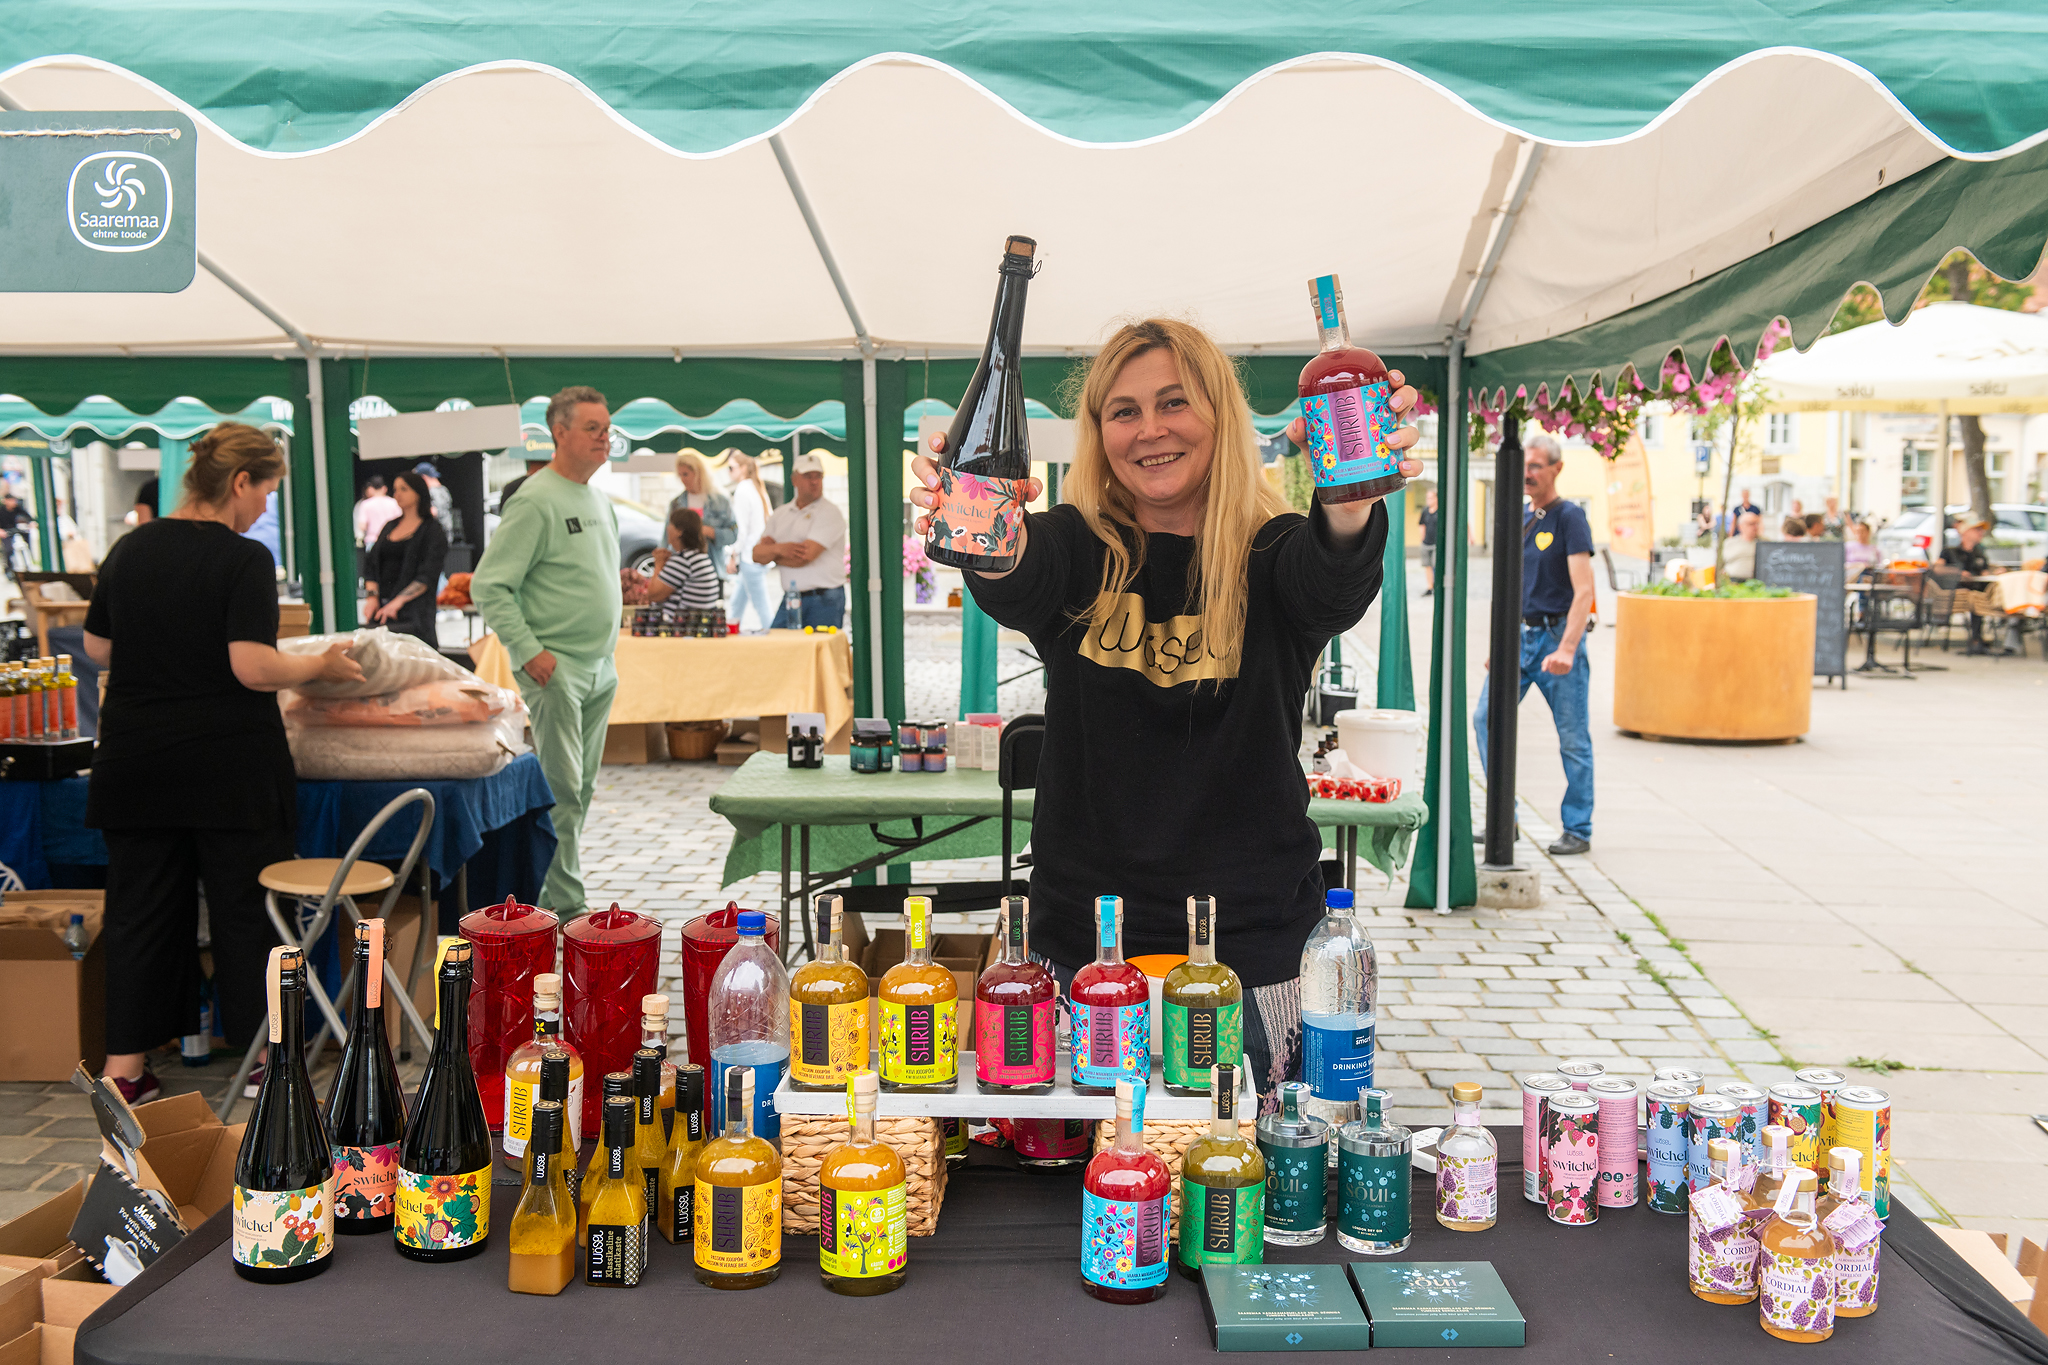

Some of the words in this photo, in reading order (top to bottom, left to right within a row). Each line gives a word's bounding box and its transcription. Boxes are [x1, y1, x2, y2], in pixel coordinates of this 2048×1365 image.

[80, 211, 159, 229] Saaremaa
[93, 229, 119, 239] ehtne
[120, 229, 147, 239] toode
[1335, 394, 1365, 456] SHRUB
[941, 501, 992, 520] switchel
[806, 1010, 823, 1062] SHRUB
[911, 1010, 930, 1062] SHRUB
[1010, 1010, 1028, 1062] SHRUB
[1096, 1012, 1114, 1064] SHRUB
[1194, 1013, 1212, 1066] SHRUB
[1332, 1061, 1367, 1071] DRINKING
[512, 1086, 528, 1137] SHRUB
[353, 1170, 397, 1187] switche
[1552, 1158, 1597, 1172] switchel
[134, 1206, 156, 1230] Maku
[647, 1177, 656, 1217] salatikaste
[716, 1193, 737, 1249] SHRUB
[821, 1191, 833, 1249] SHRUB
[118, 1207, 128, 1220] Pot
[150, 1242, 160, 1254] lid
[1141, 1205, 1160, 1263] SHRUB
[1209, 1193, 1231, 1250] SHRUB
[605, 1230, 614, 1279] Klassikaline
[1723, 1243, 1759, 1256] CORDIAL
[1835, 1263, 1873, 1273] ORDIAL
[1765, 1275, 1810, 1295] CORDIAL
